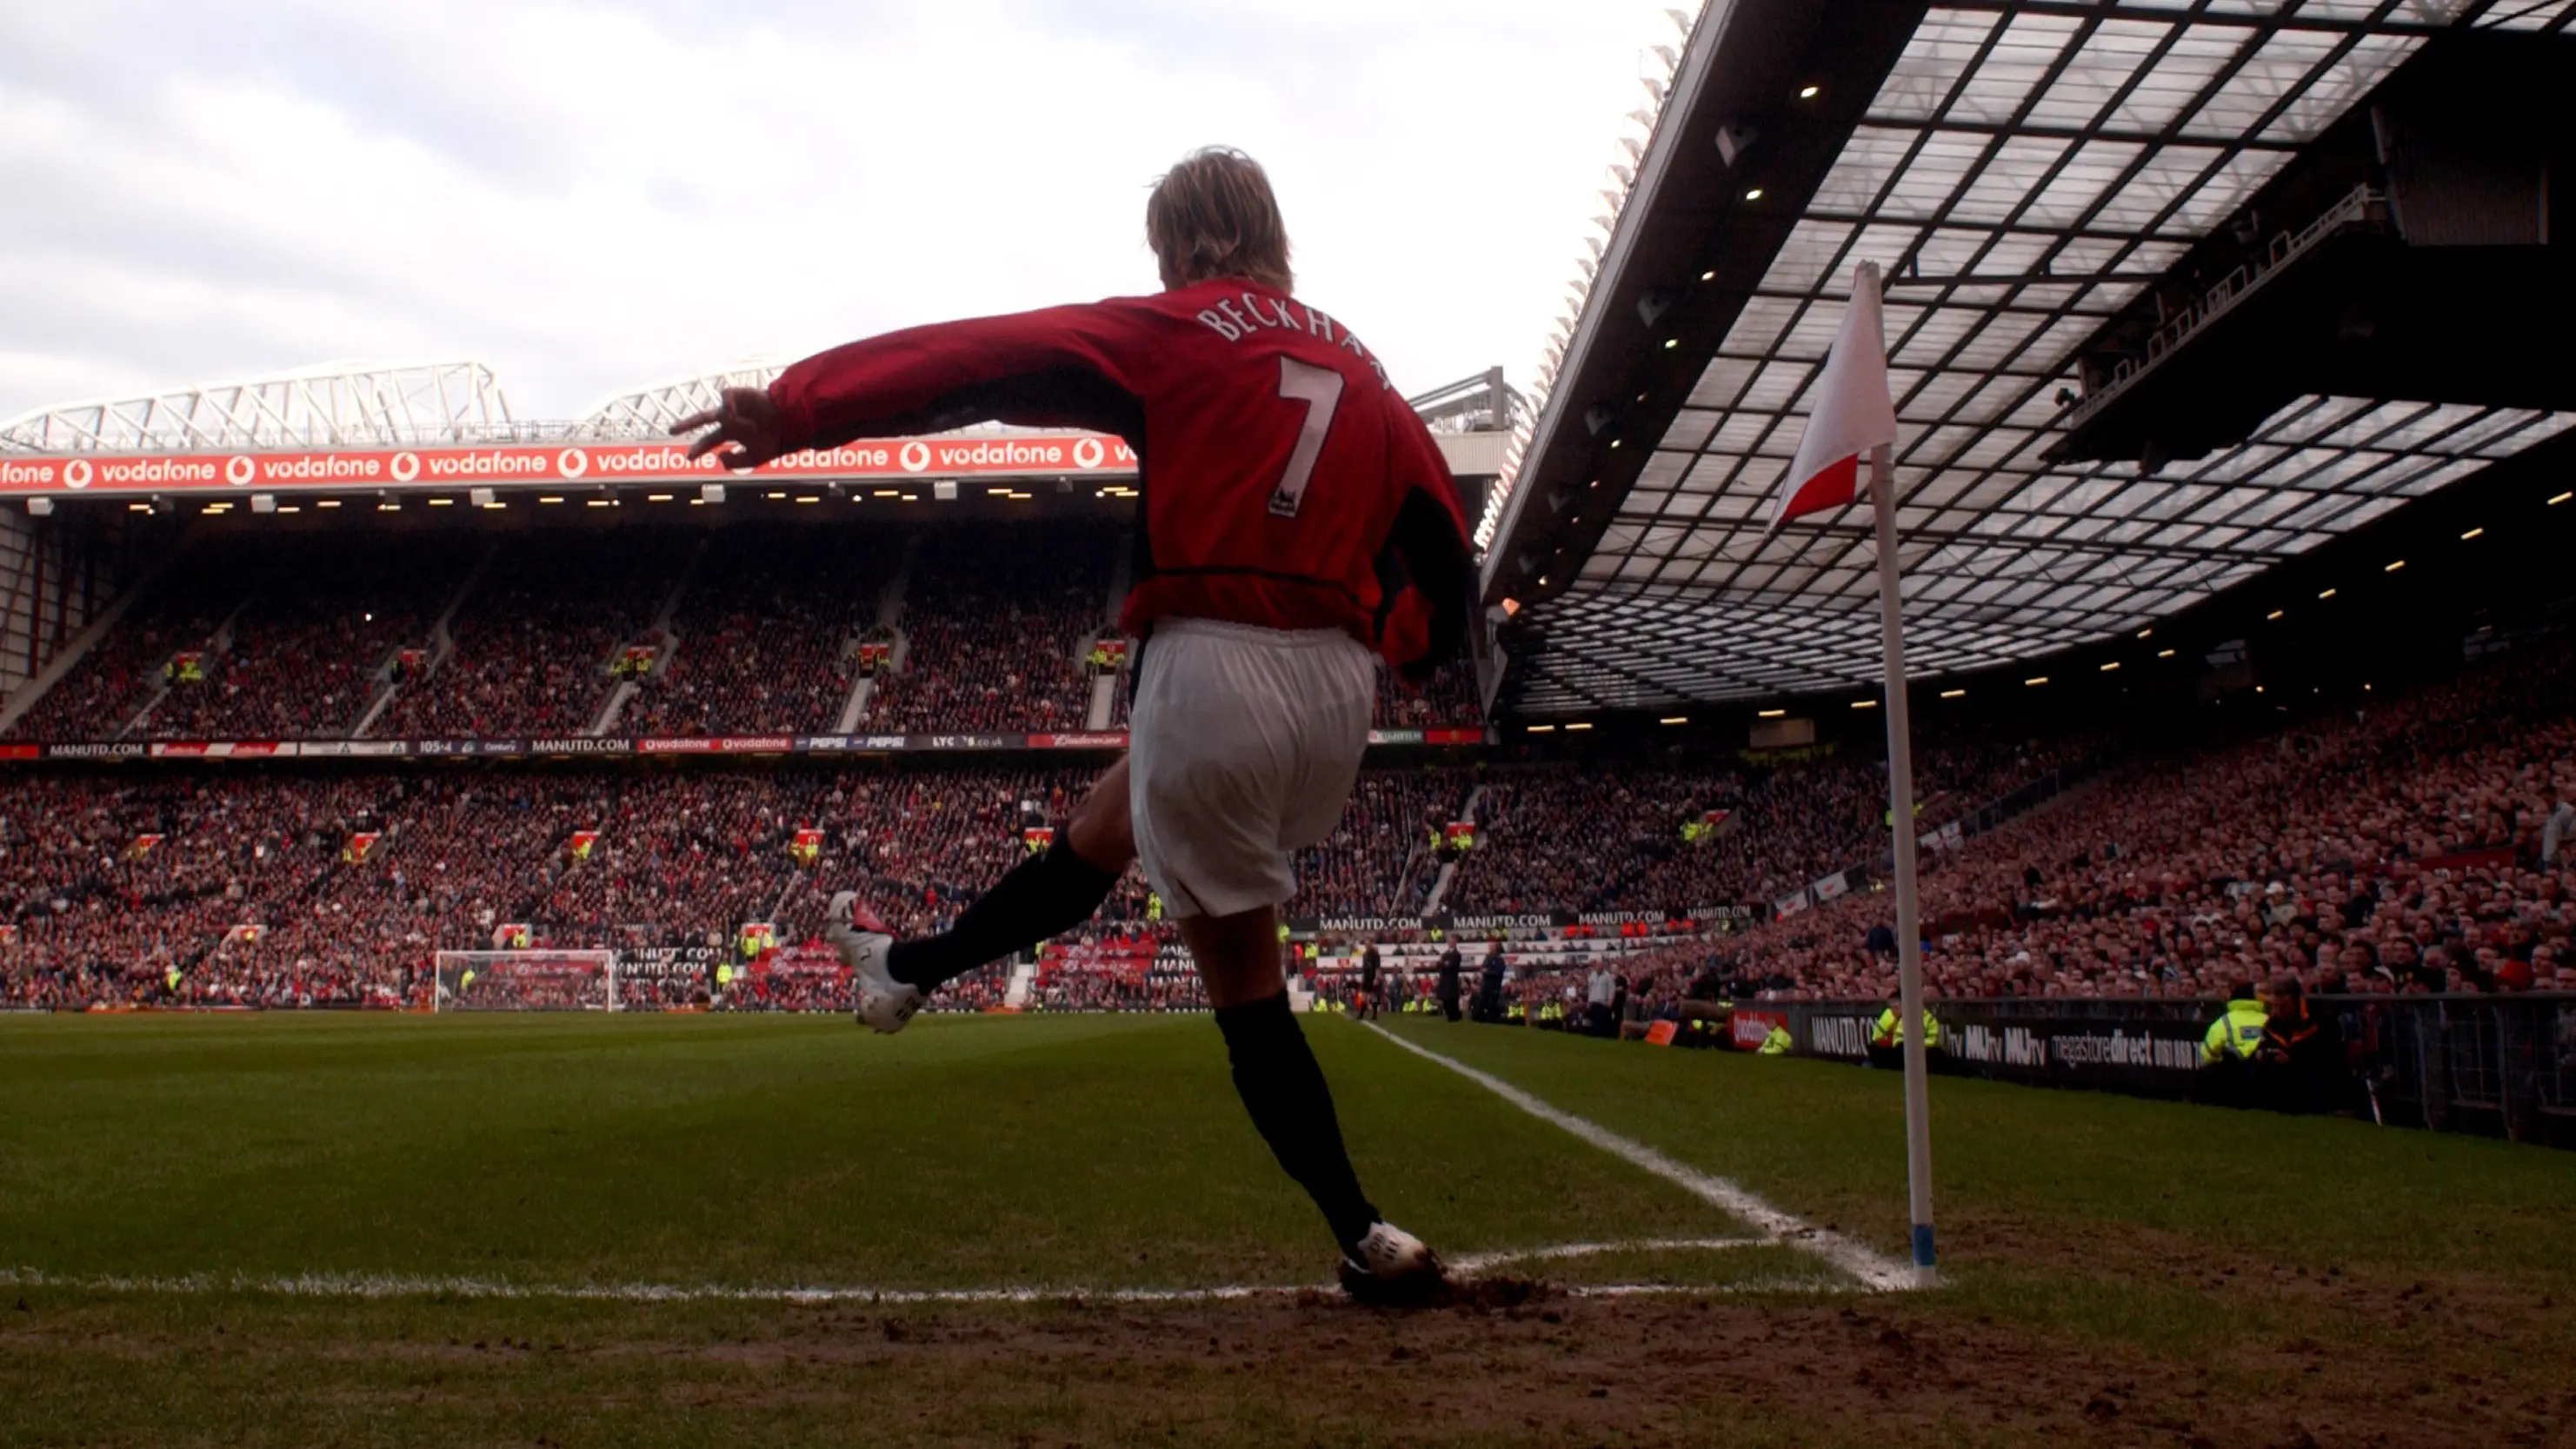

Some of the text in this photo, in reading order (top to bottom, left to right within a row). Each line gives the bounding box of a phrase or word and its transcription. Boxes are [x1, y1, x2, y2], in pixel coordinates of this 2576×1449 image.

[1268, 355, 1345, 518] 7
[0, 462, 55, 483] fone
[102, 459, 216, 482] vodafone
[264, 455, 380, 479] vodafone
[429, 451, 548, 475] vodafone
[940, 442, 1062, 465] vodafone
[50, 743, 144, 756] MANUTD.COM
[532, 739, 630, 753] MANUTD.COM
[656, 737, 788, 749] vodafone vodafone
[809, 737, 905, 748] PEPSI PEPSI
[1320, 917, 1422, 931] MANUTD.COM
[1454, 914, 1551, 928] MANUTD.COM
[1579, 910, 1665, 925] MANUTD.COM
[1812, 1015, 1878, 1057] MANUTD.CO
